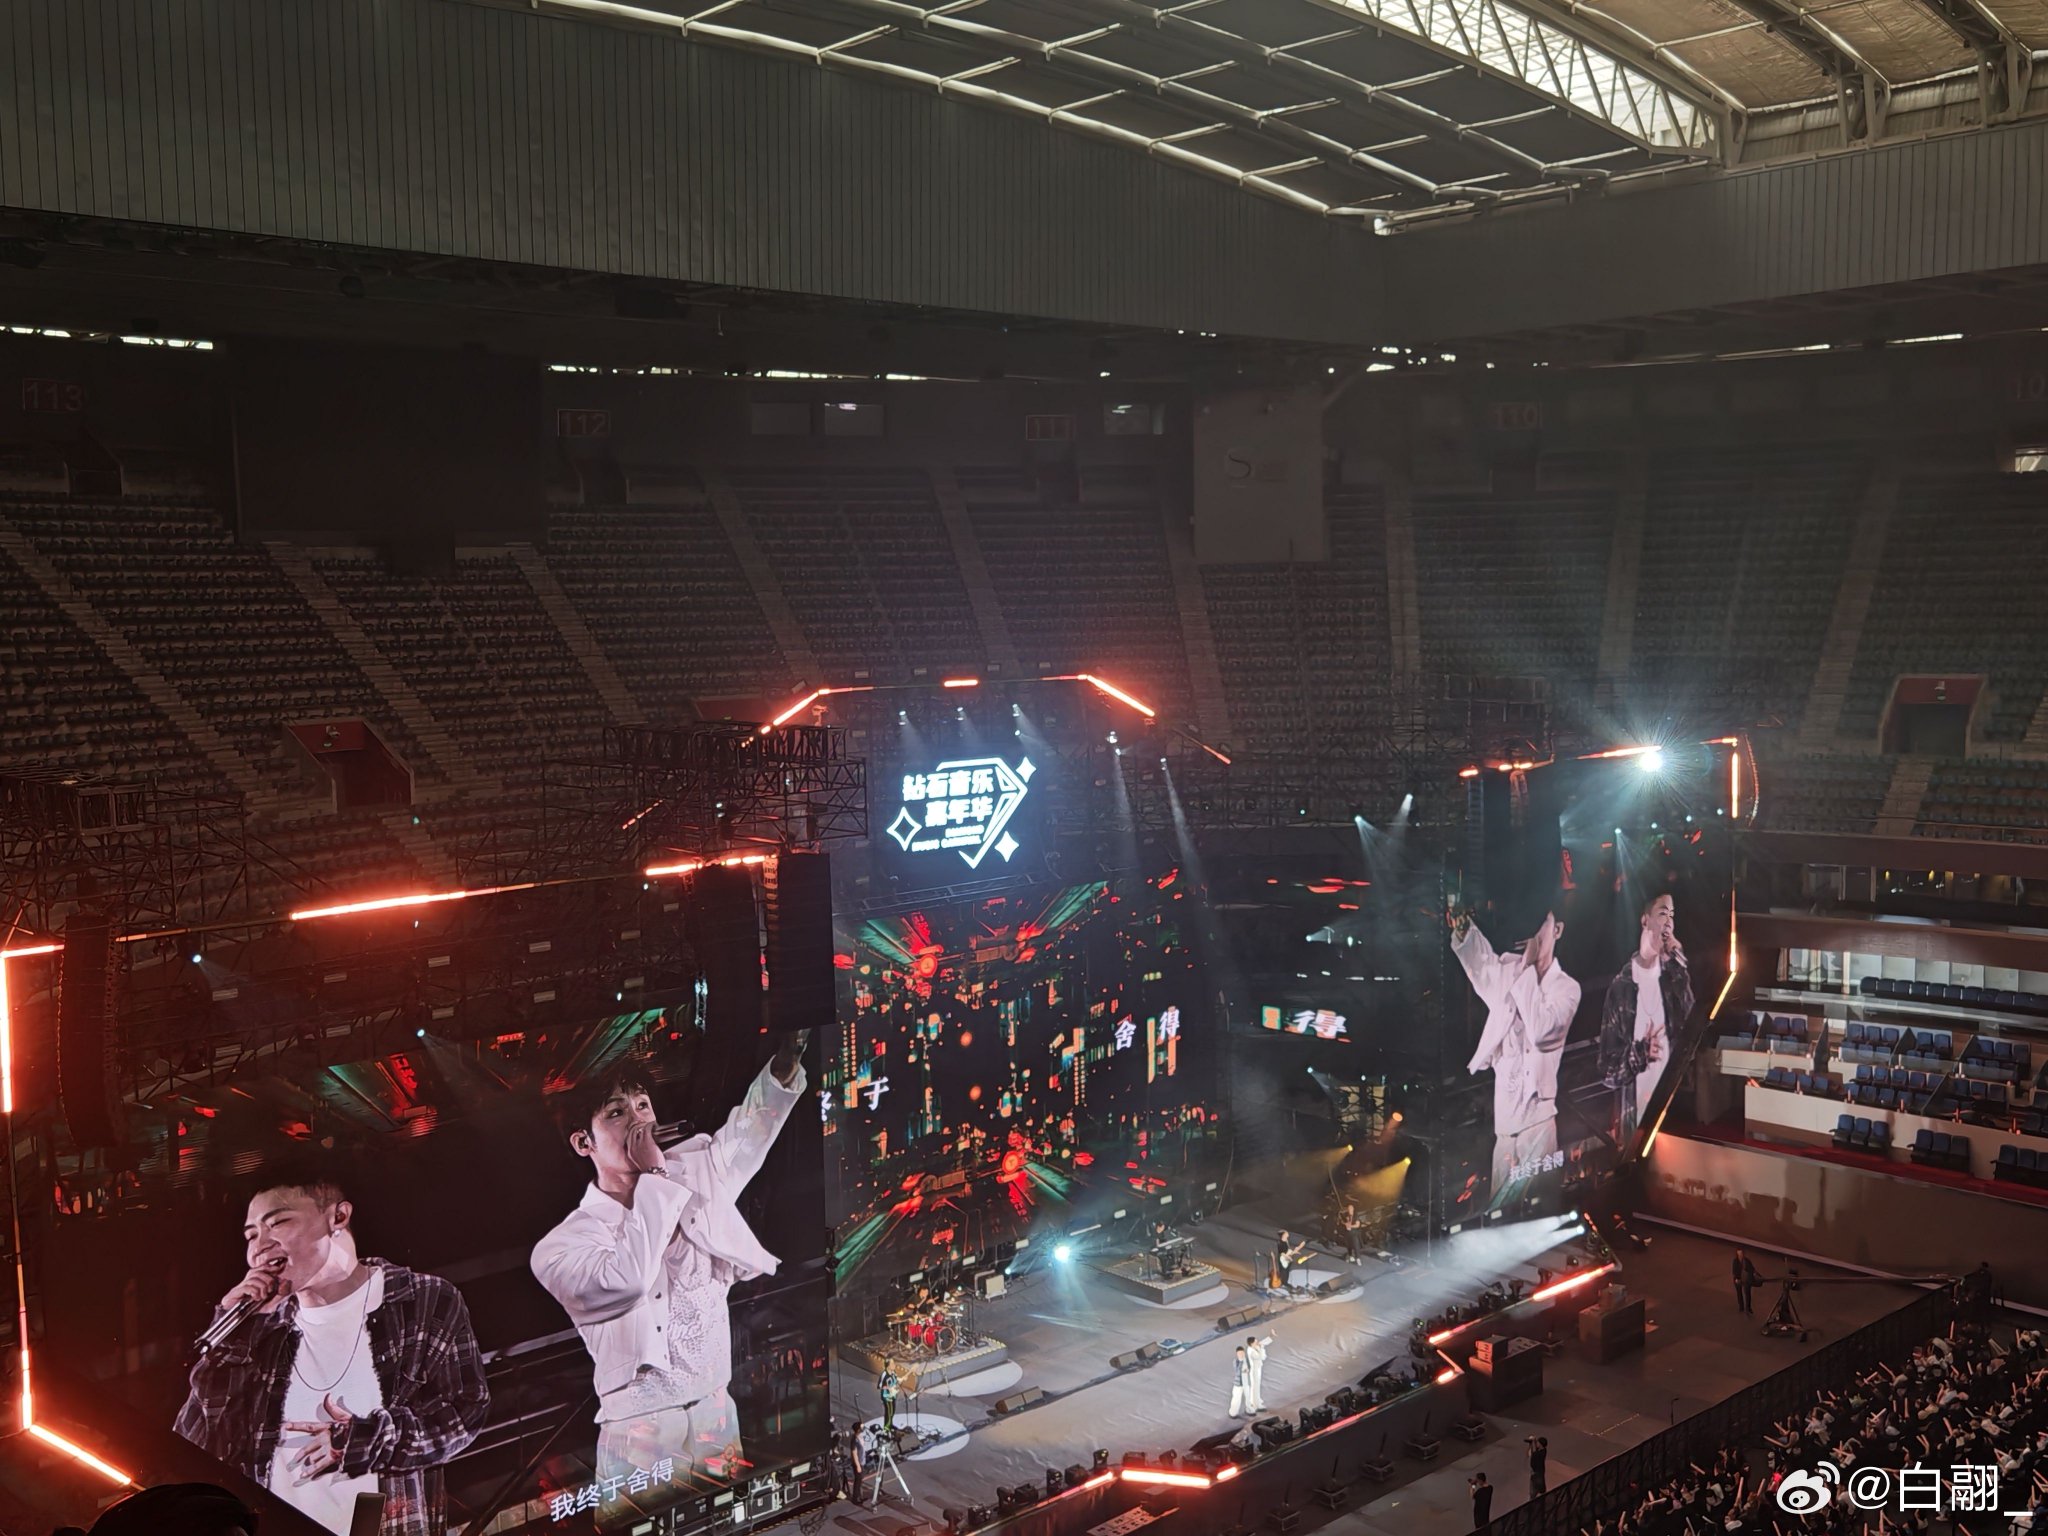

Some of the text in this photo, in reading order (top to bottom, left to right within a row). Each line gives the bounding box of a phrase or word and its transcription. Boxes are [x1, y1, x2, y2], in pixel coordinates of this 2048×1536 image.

[27, 381, 83, 412] 113
[562, 411, 606, 435] 112
[902, 768, 995, 801] 钻石音乐
[925, 796, 994, 828] 嘉年华
[550, 1458, 675, 1522] 我终于舍得
